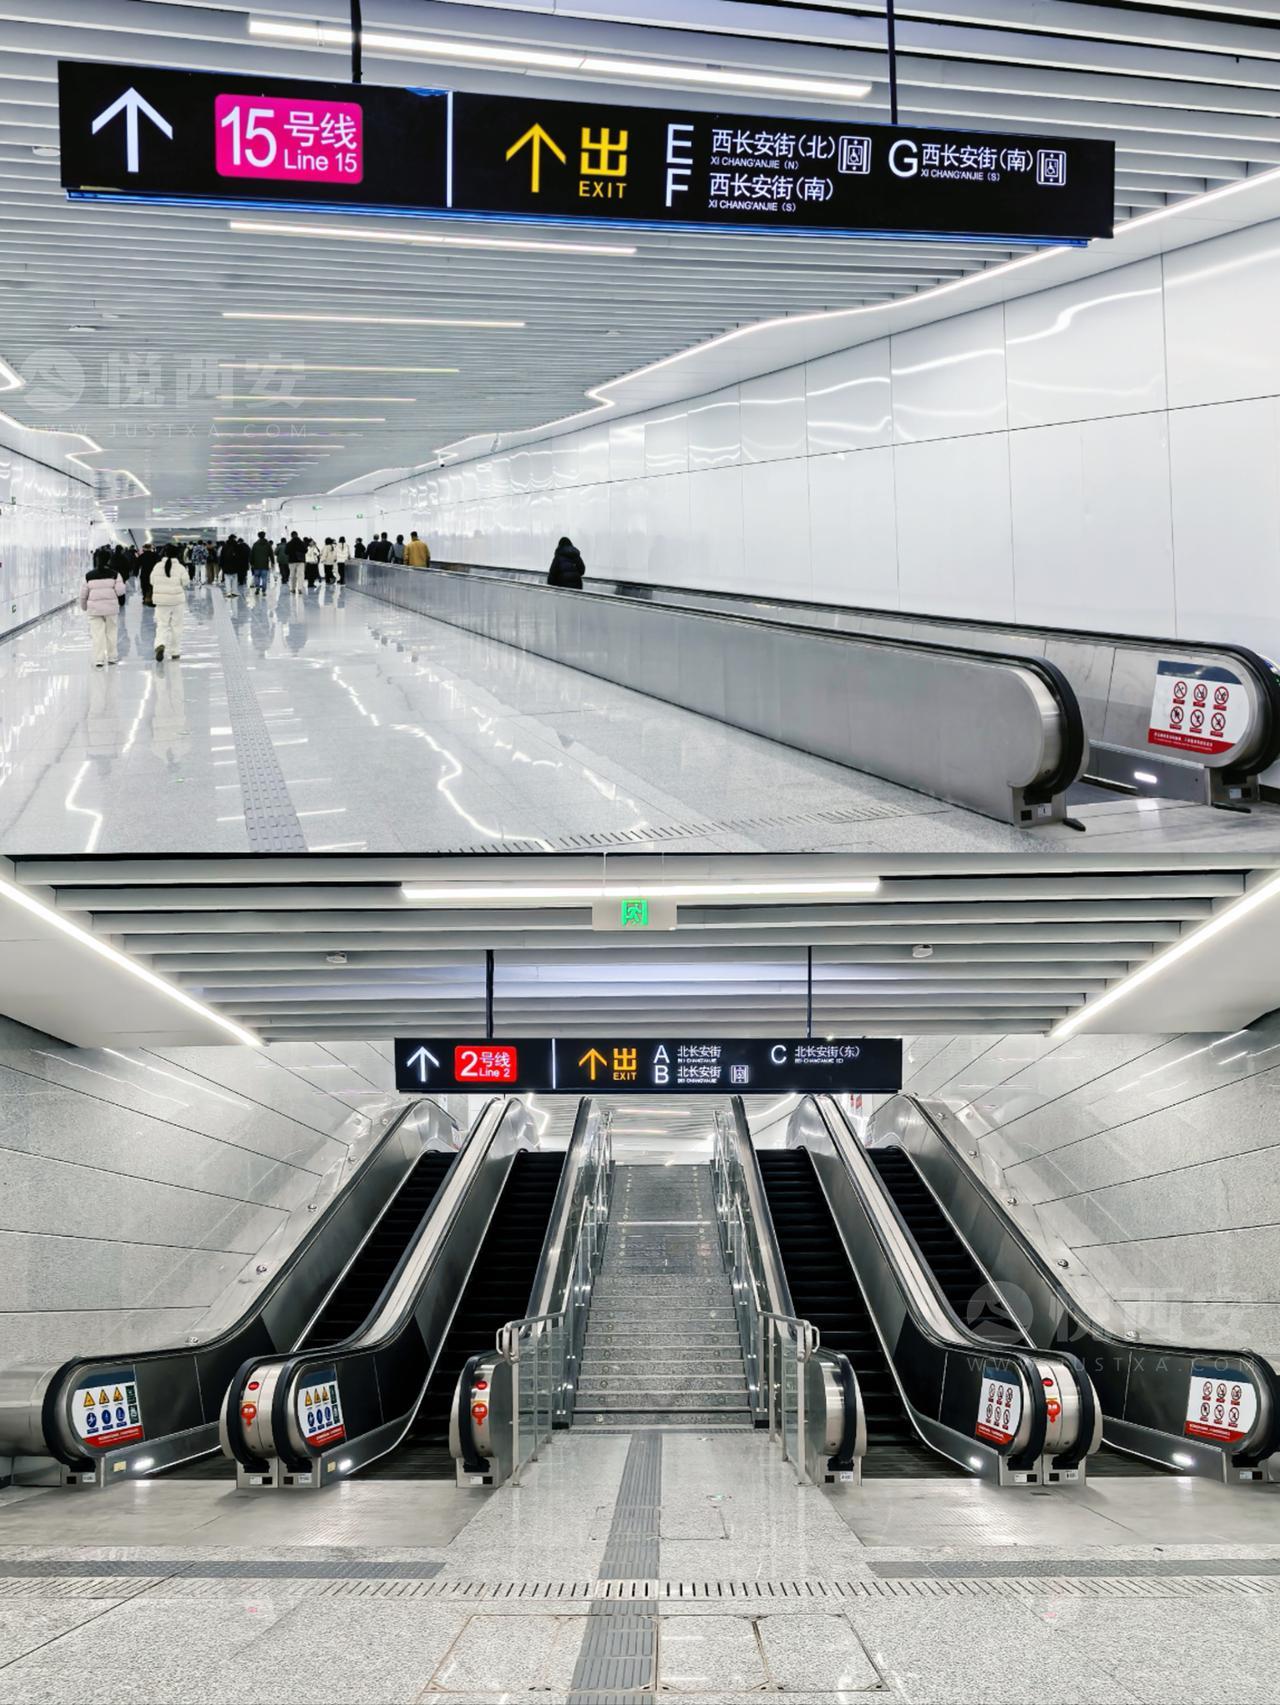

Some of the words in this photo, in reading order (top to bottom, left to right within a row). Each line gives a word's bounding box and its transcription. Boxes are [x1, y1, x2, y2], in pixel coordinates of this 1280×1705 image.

[221, 105, 278, 168] 15
[283, 111, 358, 150] 号线
[666, 123, 695, 165] E
[711, 129, 836, 160] 西长安街（北）
[283, 148, 329, 171] Line
[335, 152, 358, 173] 15
[580, 127, 629, 177] 出
[710, 155, 721, 166] XI
[721, 156, 781, 170] CHANG'ANJIE
[887, 138, 919, 178] G
[921, 143, 1034, 173] 西长安街（南）
[920, 168, 930, 178] XI
[578, 180, 628, 199] EXIT
[665, 167, 692, 207] F
[709, 172, 834, 202] 西长安街（南）
[708, 199, 719, 209] XI
[719, 200, 778, 212] CHANG'ANJIE
[613, 1047, 637, 1071] 出
[653, 1044, 670, 1064] A
[677, 1045, 721, 1058] 北长安街
[770, 1044, 787, 1065] C
[460, 1051, 478, 1077] 2
[479, 1051, 511, 1068] 号线
[479, 1067, 500, 1078] Line
[503, 1067, 511, 1078] 2
[654, 1064, 669, 1084] B
[677, 1065, 721, 1078] 北长安街
[613, 1071, 637, 1081] EXIT
